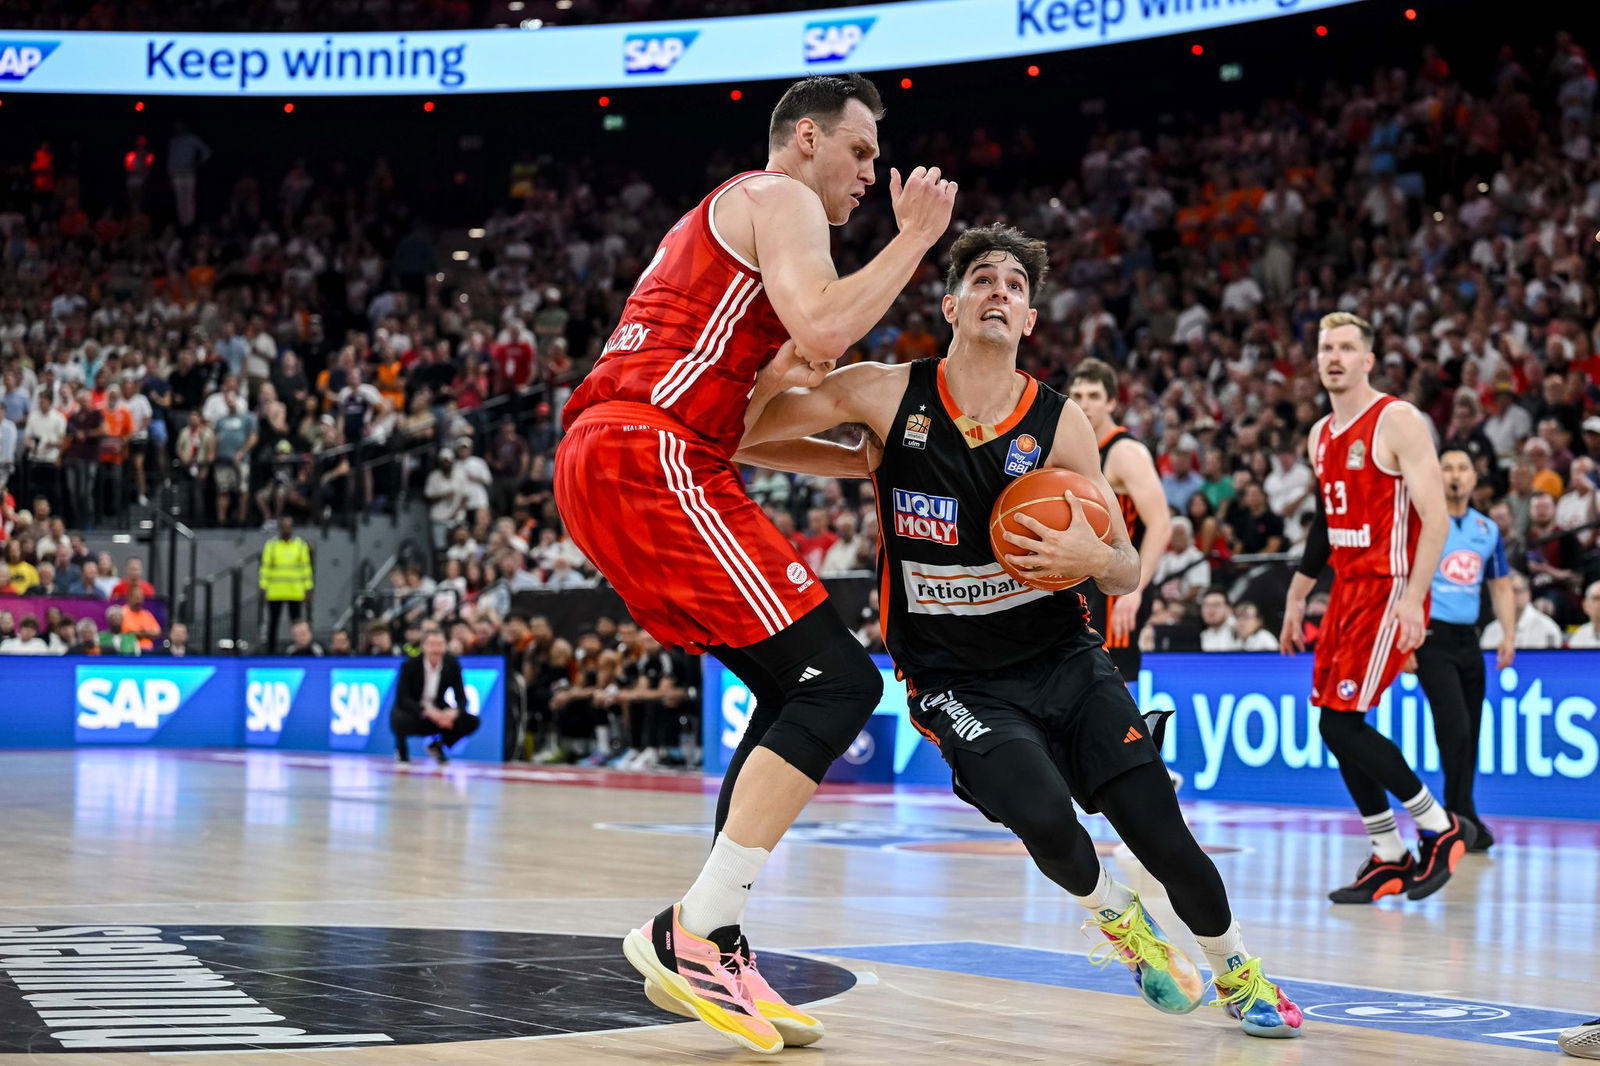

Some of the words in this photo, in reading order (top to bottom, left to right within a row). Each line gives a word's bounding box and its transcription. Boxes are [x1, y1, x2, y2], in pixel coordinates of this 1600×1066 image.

[1016, 0, 1126, 36] Keep
[0, 46, 42, 77] AP
[624, 38, 683, 71] SAP
[804, 26, 862, 61] SAP
[146, 40, 268, 88] Keep
[282, 36, 467, 87] winning
[896, 491, 953, 520] LIQUI
[898, 514, 956, 542] MOLY
[76, 678, 181, 729] SAP
[246, 680, 291, 733] SAP
[329, 681, 381, 735] SAP
[1192, 693, 1339, 791] you
